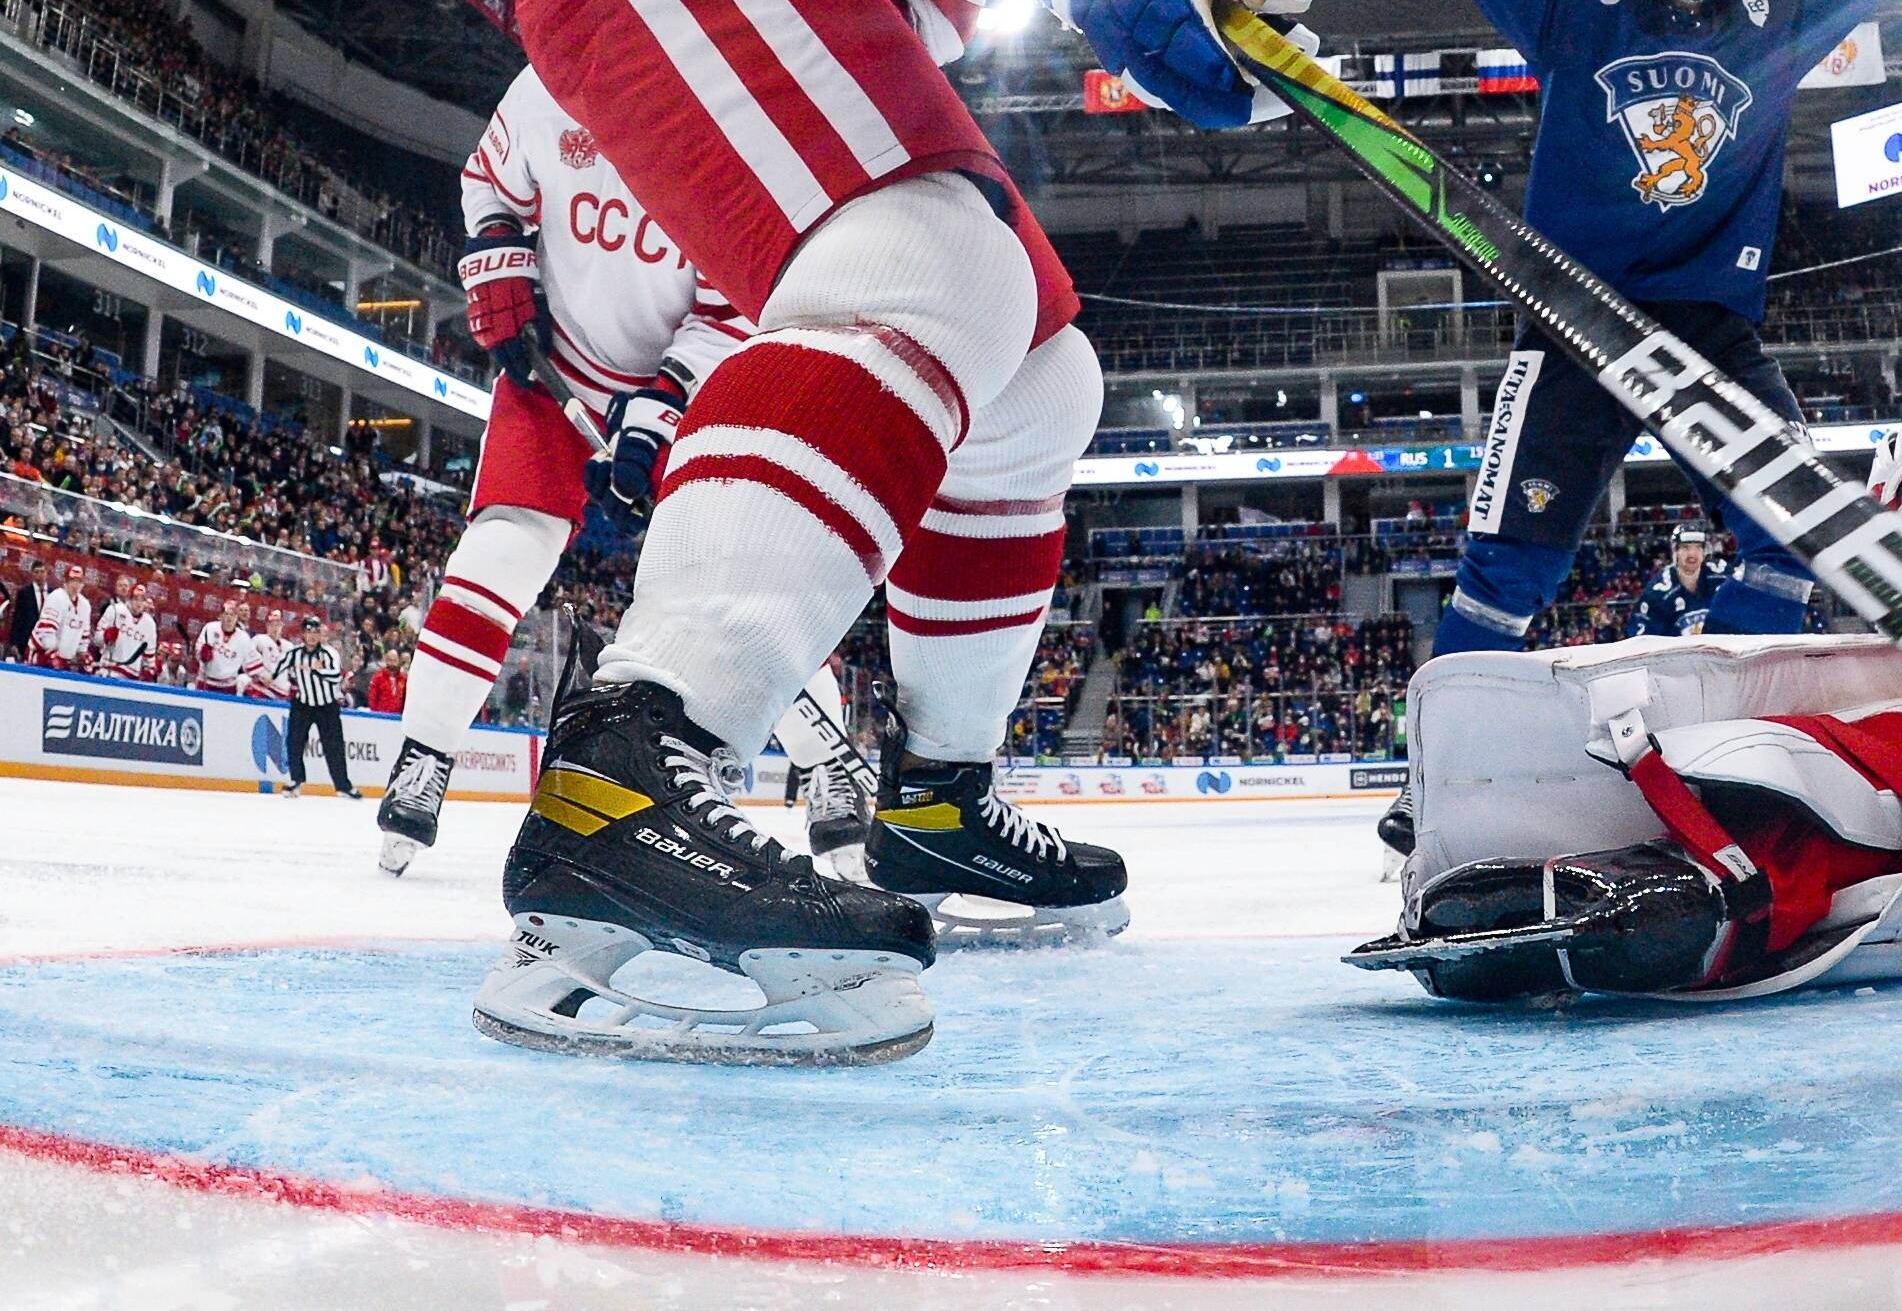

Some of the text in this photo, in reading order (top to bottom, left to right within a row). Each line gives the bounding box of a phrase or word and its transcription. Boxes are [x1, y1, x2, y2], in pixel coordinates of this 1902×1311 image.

[1627, 66, 1725, 105] SUOMI
[12, 190, 63, 221] NORNICKEL
[122, 243, 167, 269] NORNICKEL
[1401, 452, 1428, 466] RUS
[1443, 448, 1455, 468] 1
[76, 709, 178, 748] БАЛТИКА
[634, 826, 735, 880] BAUER
[971, 854, 1034, 885] BAUER
